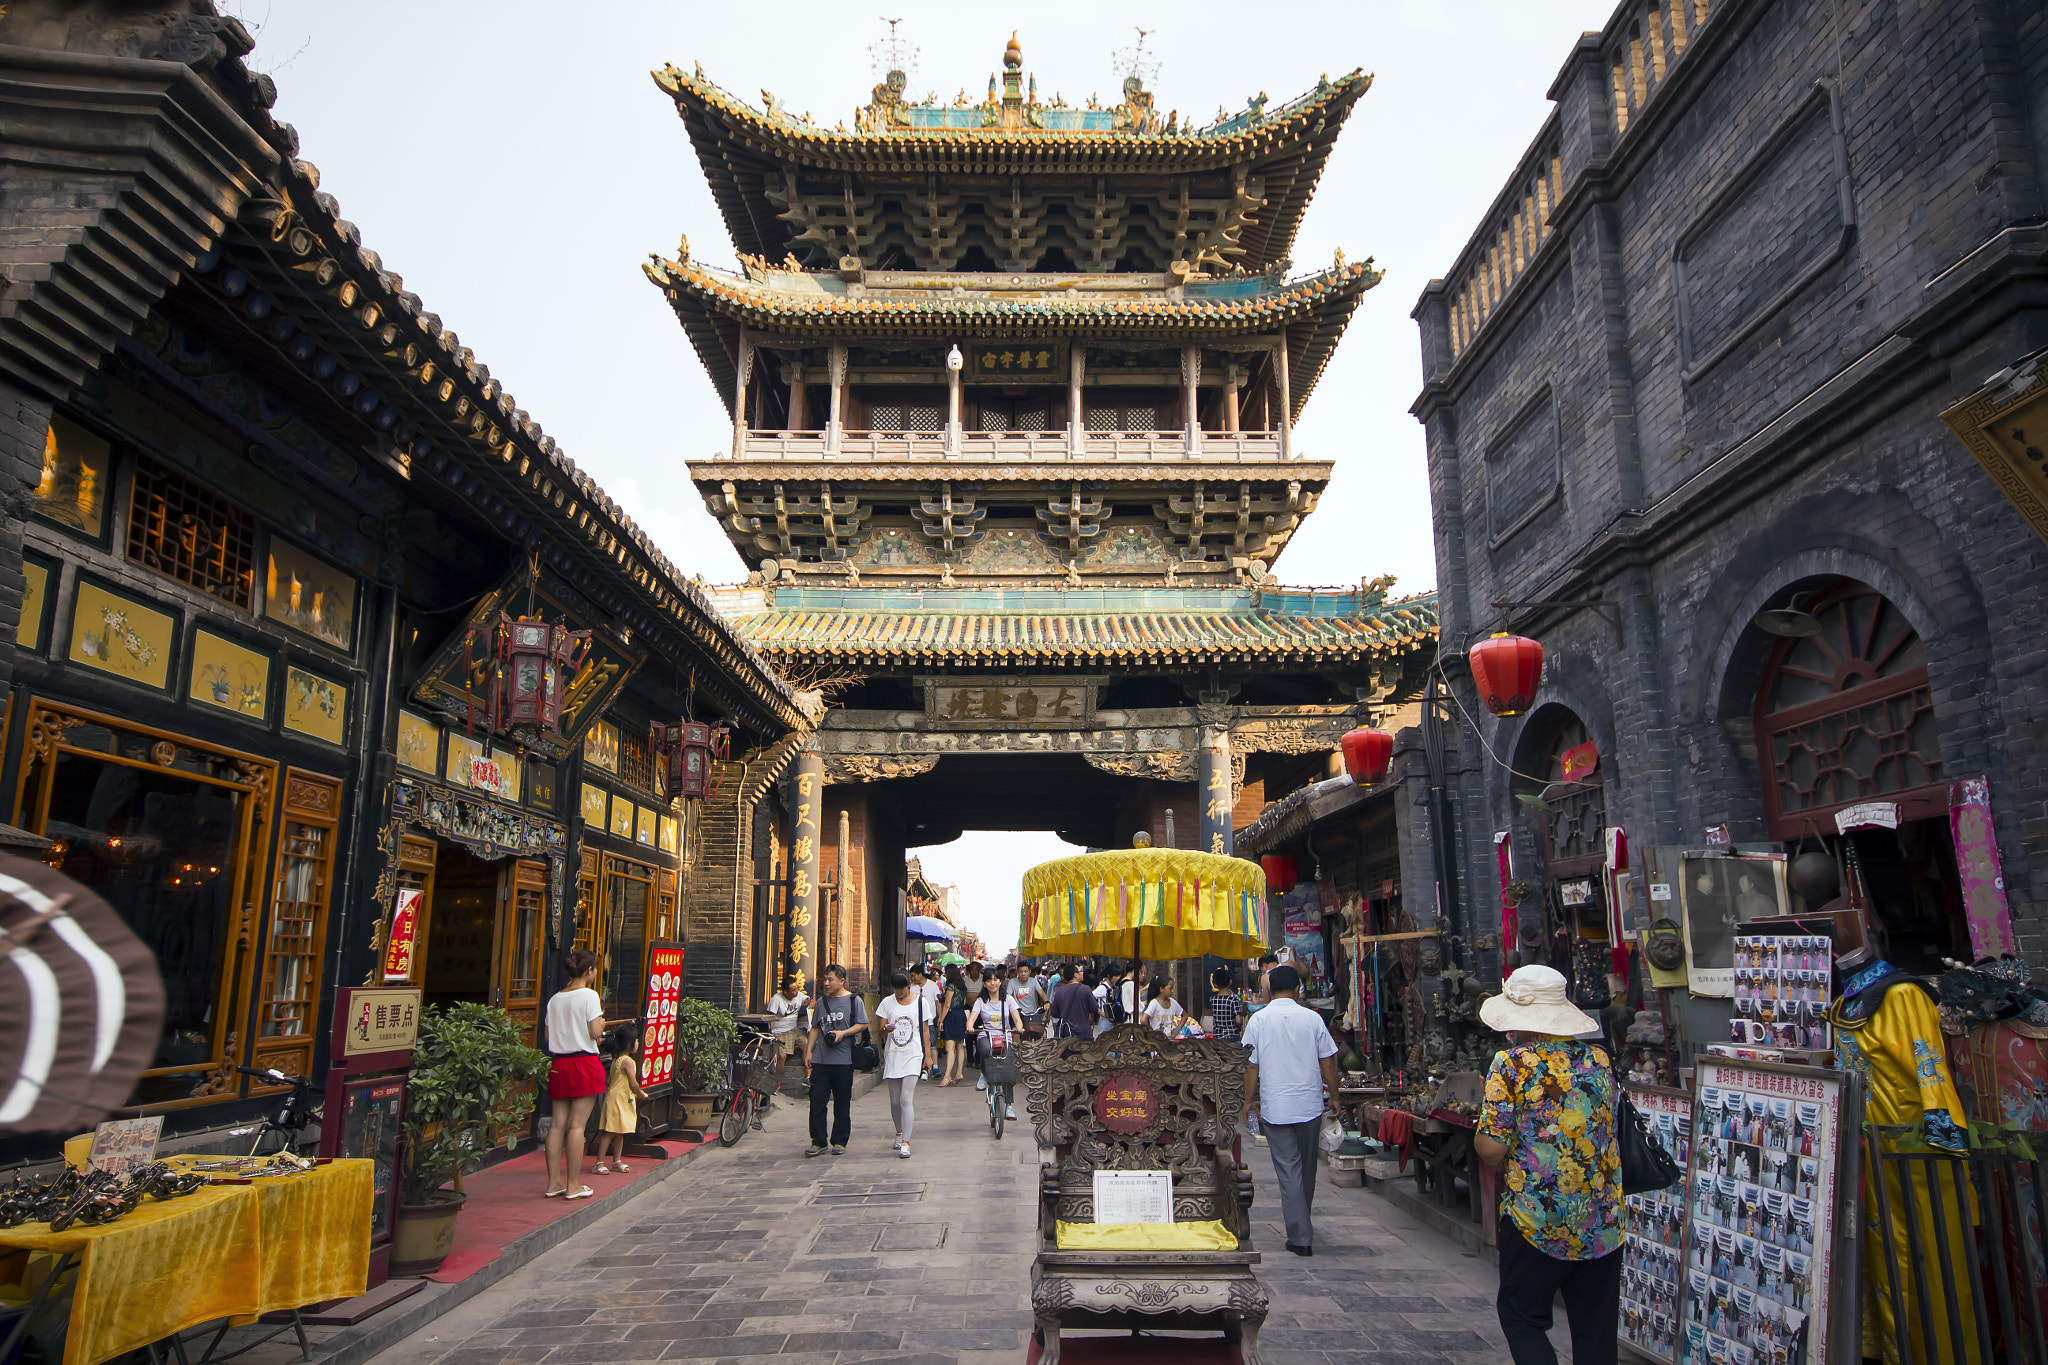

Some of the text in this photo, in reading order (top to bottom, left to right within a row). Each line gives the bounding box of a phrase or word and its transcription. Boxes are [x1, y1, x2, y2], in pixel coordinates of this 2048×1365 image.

[395, 903, 415, 972] 今日有房
[375, 1003, 414, 1030] 售票点
[1715, 1067, 1825, 1100] 数码快照 出租服装道具永久留念
[1106, 1107, 1146, 1118] 交好运
[1642, 1093, 1658, 1109] 烤杯
[1661, 1095, 1678, 1113] 烤盘
